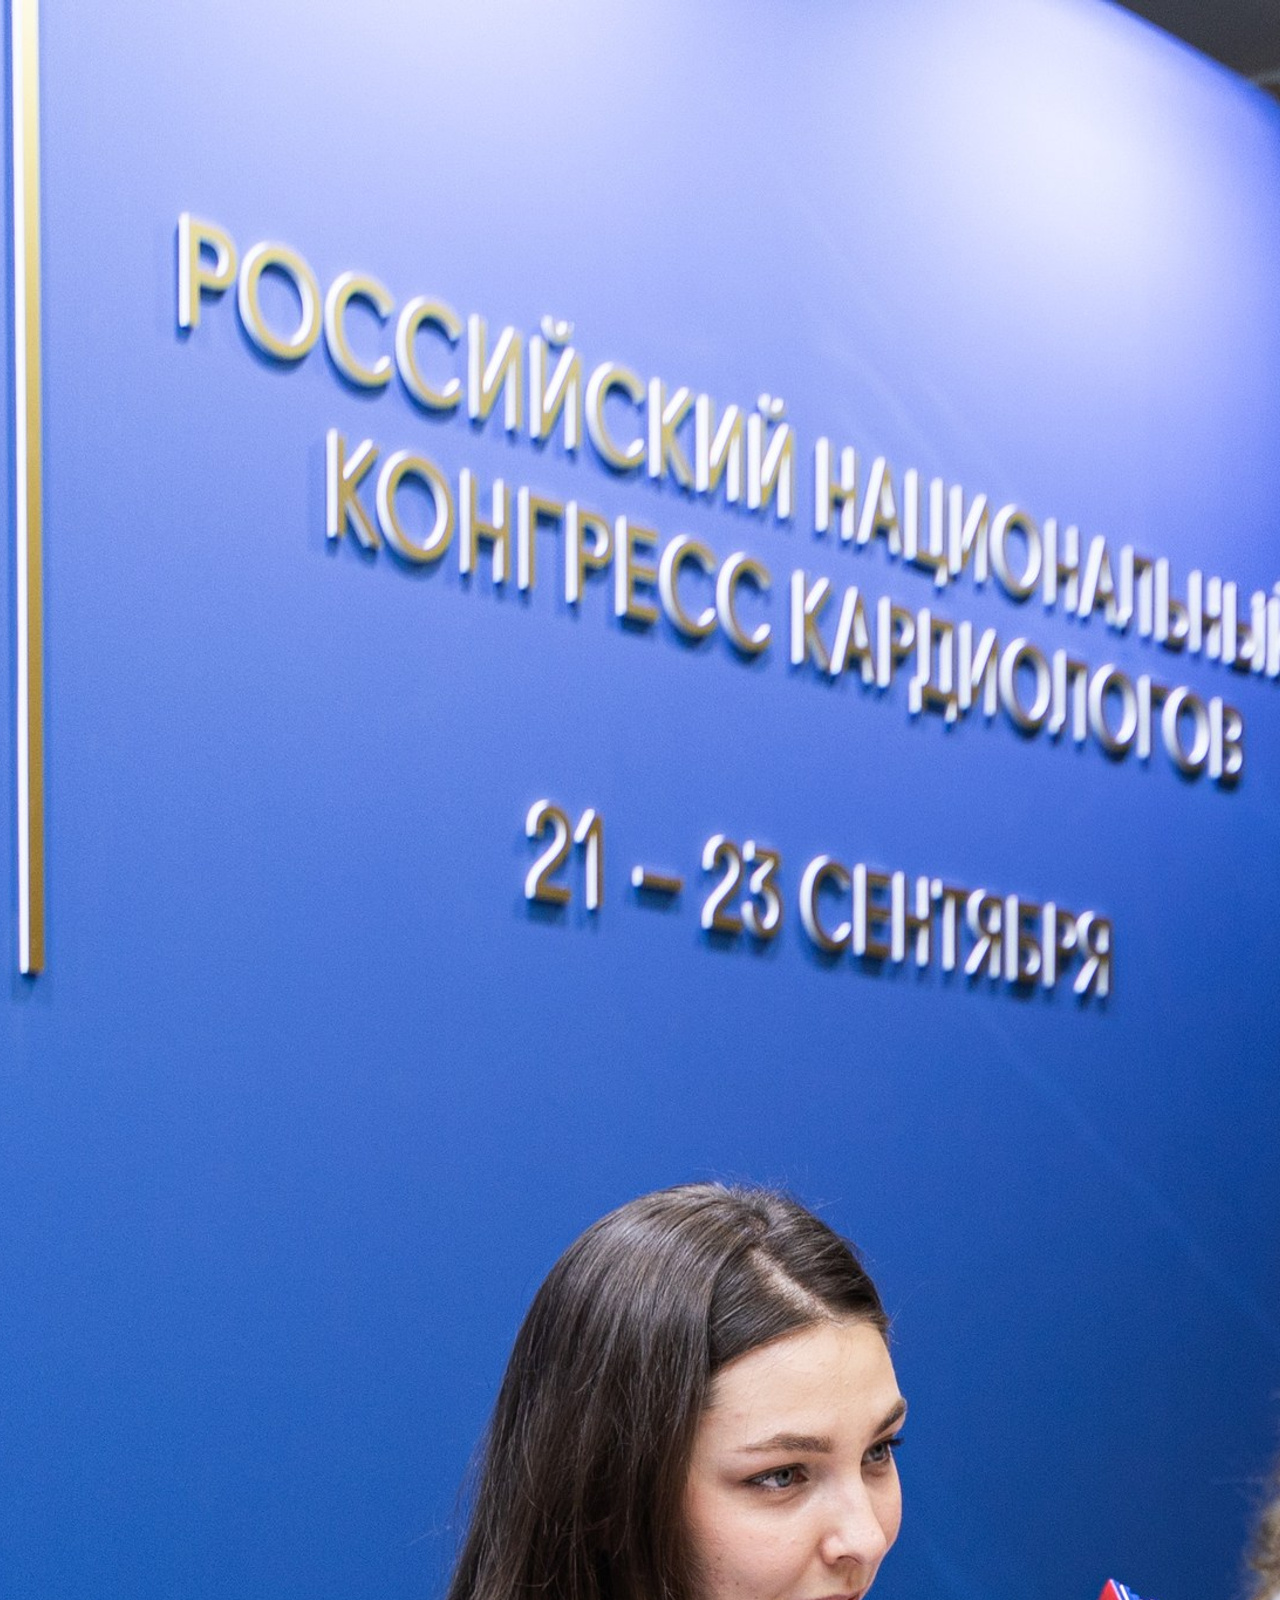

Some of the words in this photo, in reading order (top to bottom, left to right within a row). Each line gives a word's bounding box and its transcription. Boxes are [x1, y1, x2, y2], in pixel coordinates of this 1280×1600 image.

[177, 212, 792, 519] РОССИЙСКИЙ
[326, 428, 772, 655] КОНГРЕСС
[792, 570, 1245, 784] КАРДИОЛОГОВ
[524, 800, 602, 910] 21
[700, 834, 783, 940] 23
[799, 854, 1114, 1000] СЕНТЯБРЯ
